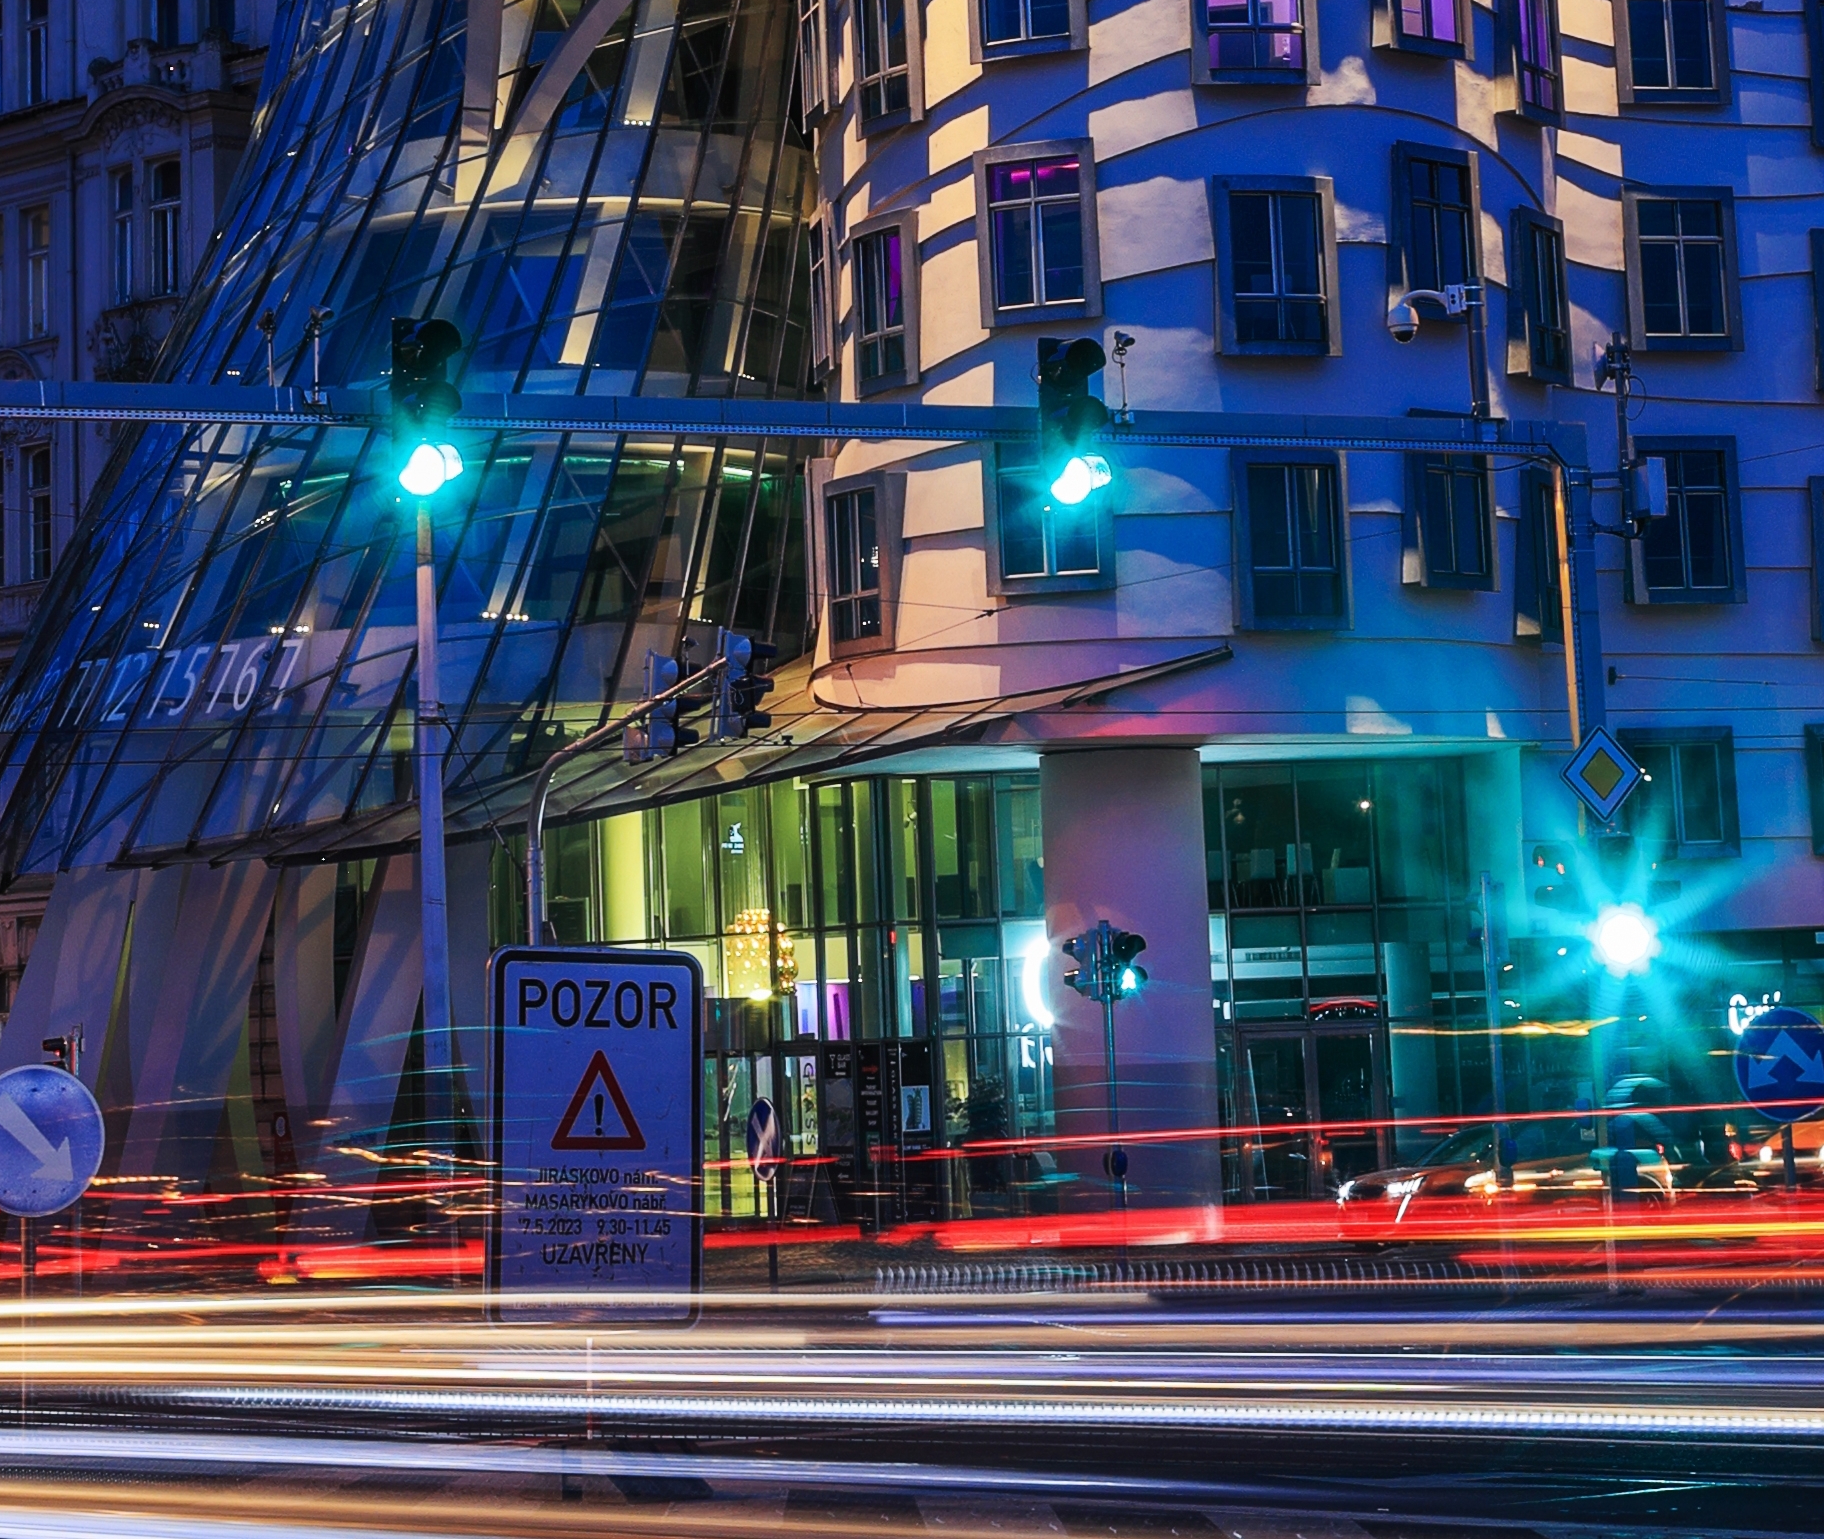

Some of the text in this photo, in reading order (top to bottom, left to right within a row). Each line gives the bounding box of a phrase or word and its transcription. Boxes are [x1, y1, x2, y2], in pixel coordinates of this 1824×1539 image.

[517, 978, 678, 1030] POZOR
[802, 1062, 817, 1146] GLASS
[534, 1164, 620, 1184] JIRÁSKOVO
[525, 1193, 667, 1210] MASARYKOVO nábř.
